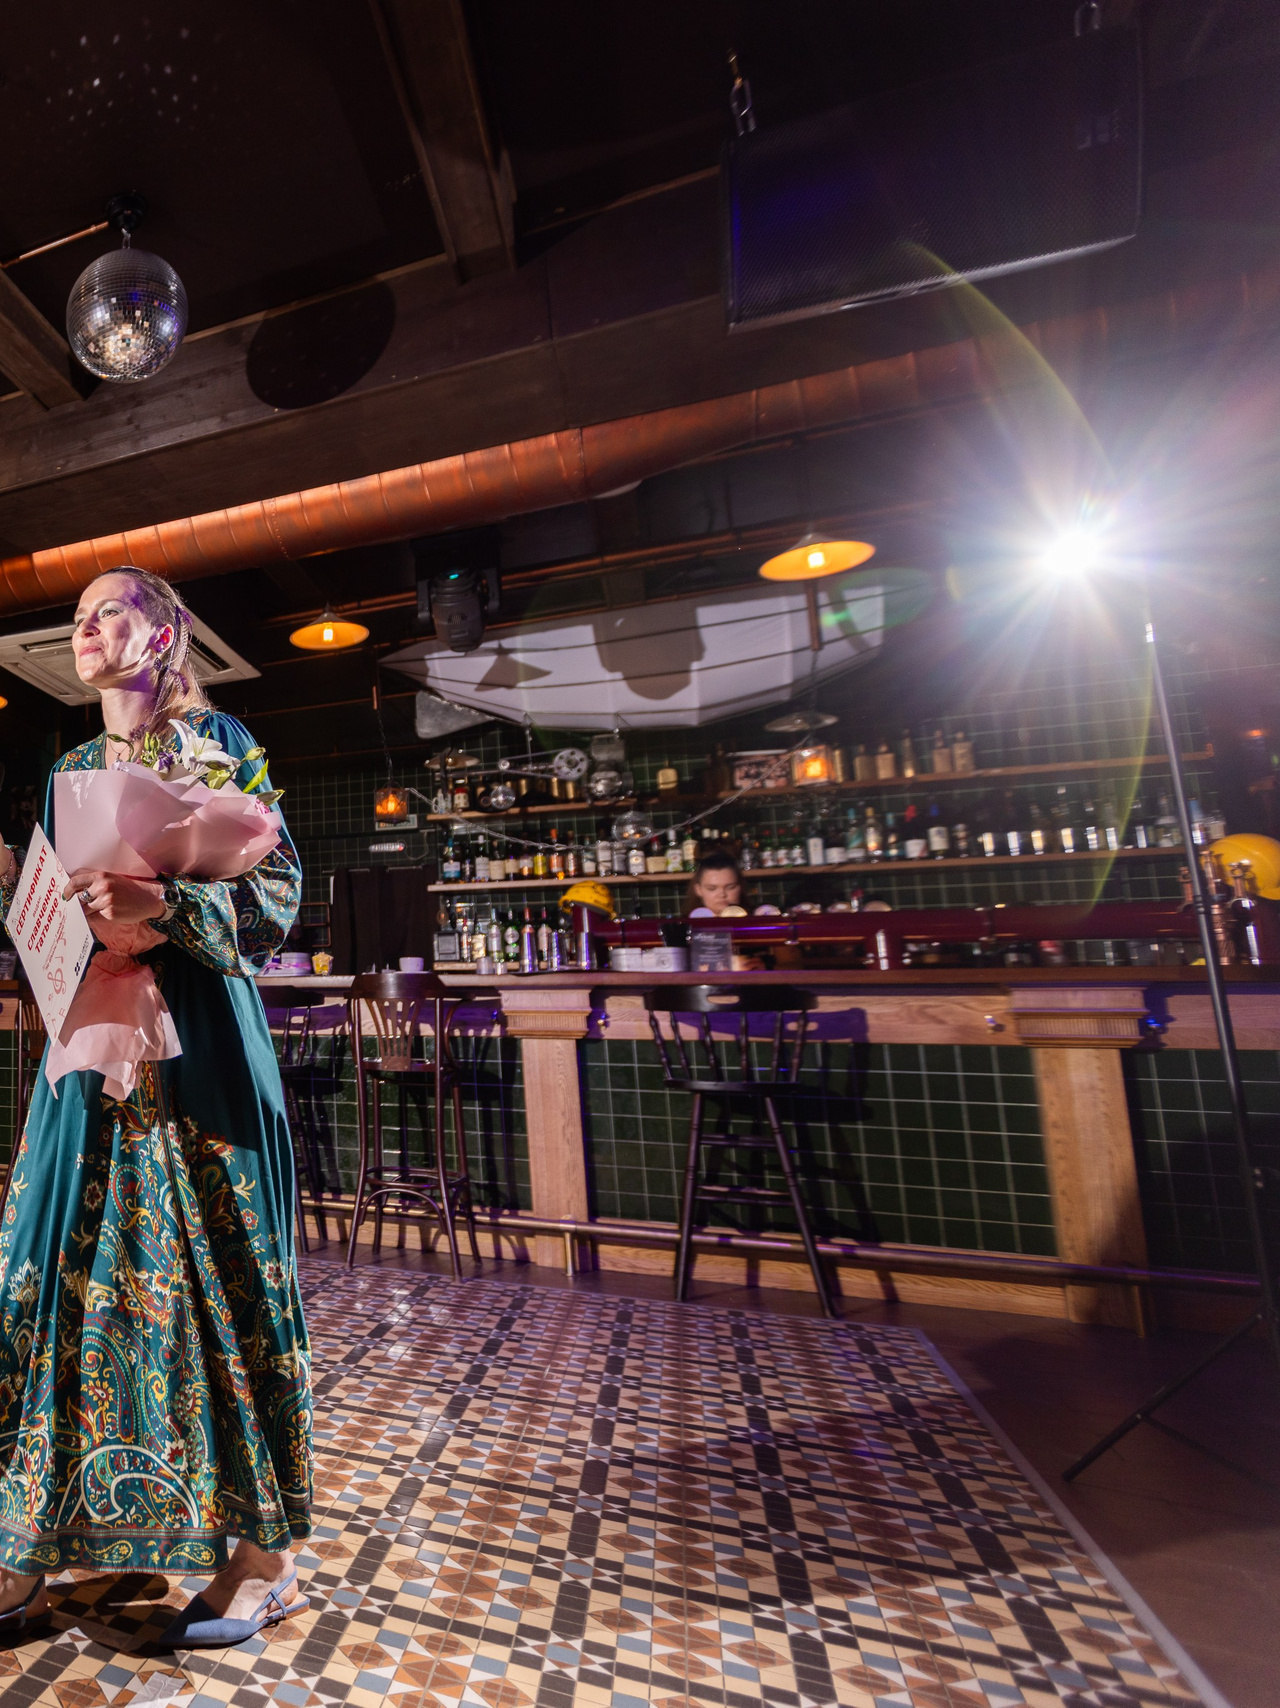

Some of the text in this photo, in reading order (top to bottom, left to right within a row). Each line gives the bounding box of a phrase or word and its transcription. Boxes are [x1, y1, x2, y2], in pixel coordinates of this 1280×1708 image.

[16, 845, 48, 935] СЕРТИФИКАТ
[27, 877, 56, 951] Славченко
[35, 898, 59, 953] Татьяне
